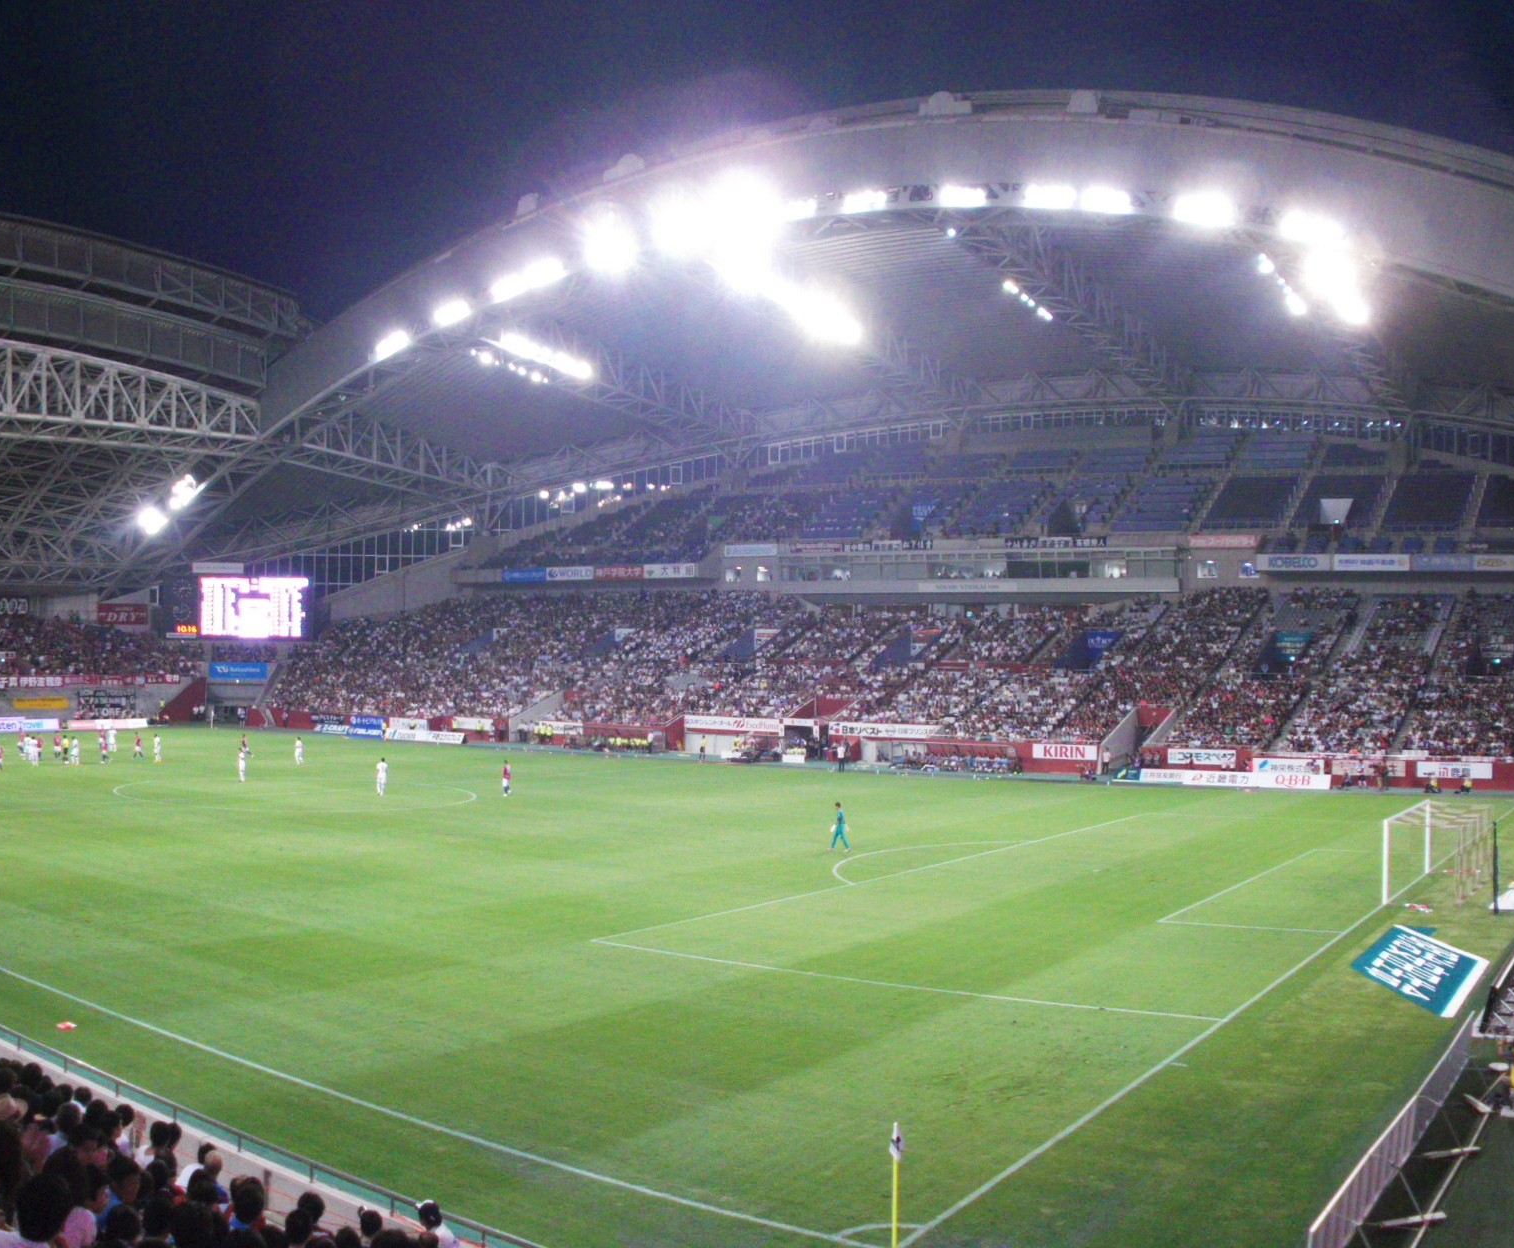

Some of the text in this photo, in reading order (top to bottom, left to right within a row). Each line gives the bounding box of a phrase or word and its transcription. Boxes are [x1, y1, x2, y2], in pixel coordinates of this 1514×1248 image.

[1268, 556, 1318, 569] KOBELCO
[558, 568, 592, 578] WORLD
[19, 720, 44, 730] Travel
[1043, 745, 1086, 759] KIRIN
[1364, 933, 1461, 1001] 明治安田生命
